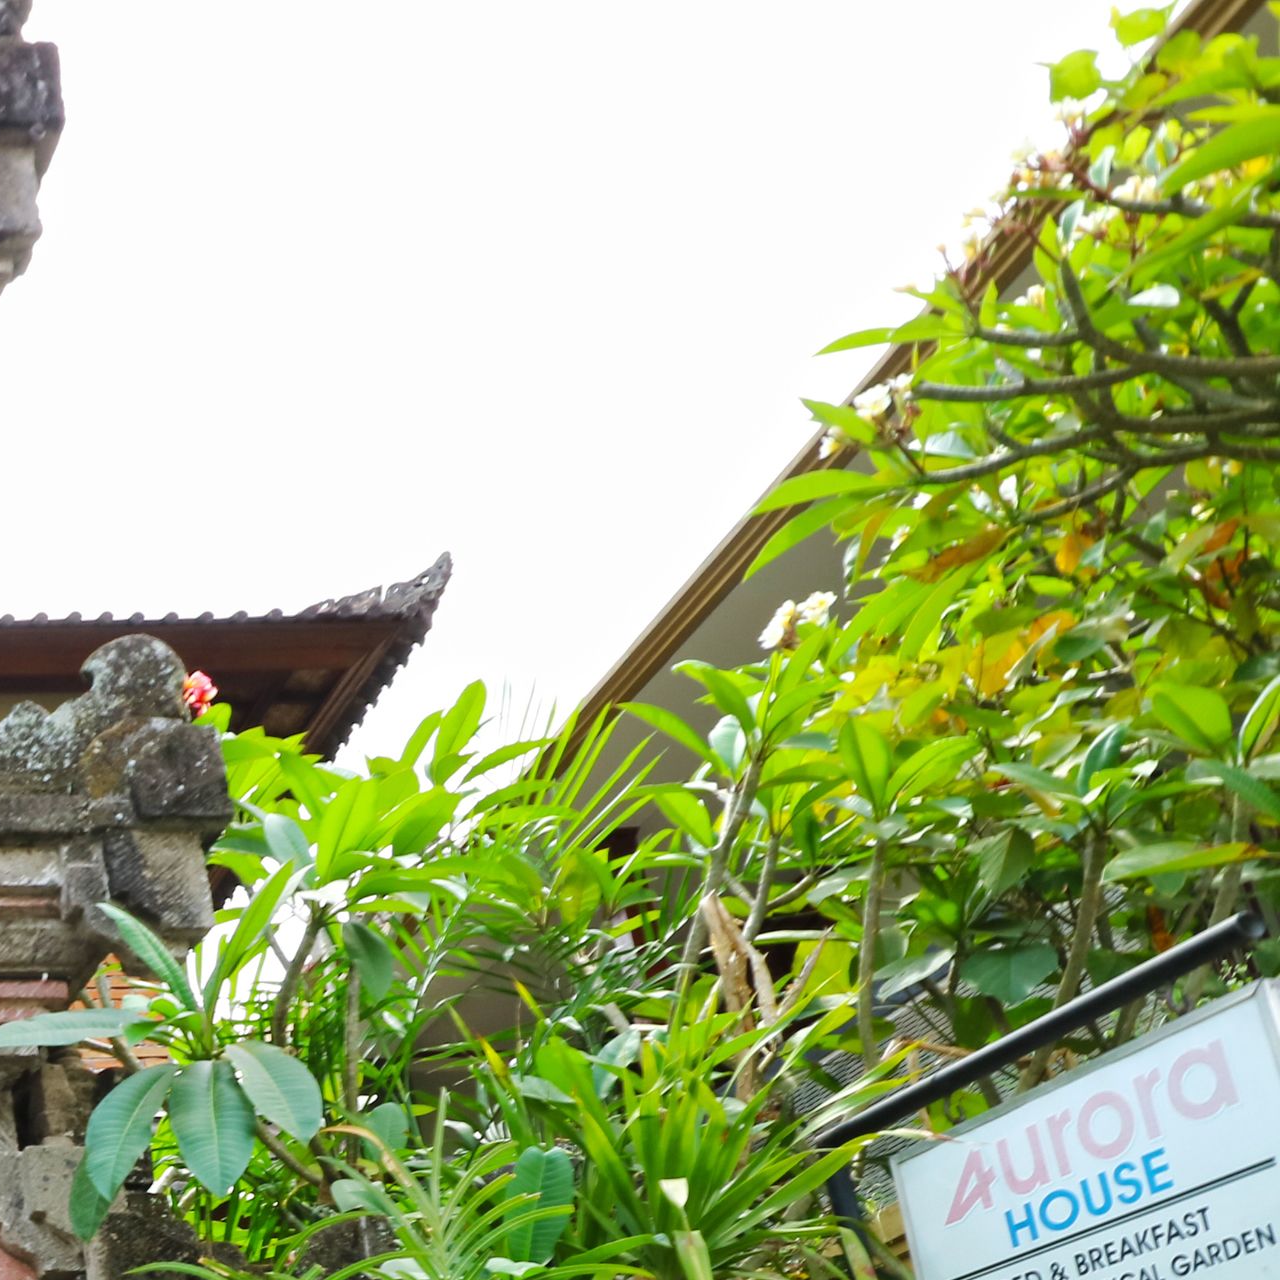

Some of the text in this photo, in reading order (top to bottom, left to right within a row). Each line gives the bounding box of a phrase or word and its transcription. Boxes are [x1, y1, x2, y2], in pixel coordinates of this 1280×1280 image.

[944, 1038, 1239, 1226] Aurora
[1004, 1147, 1174, 1248] HOUSE
[1074, 1206, 1211, 1276] BREAKFAST
[1171, 1223, 1277, 1277] GARDEN
